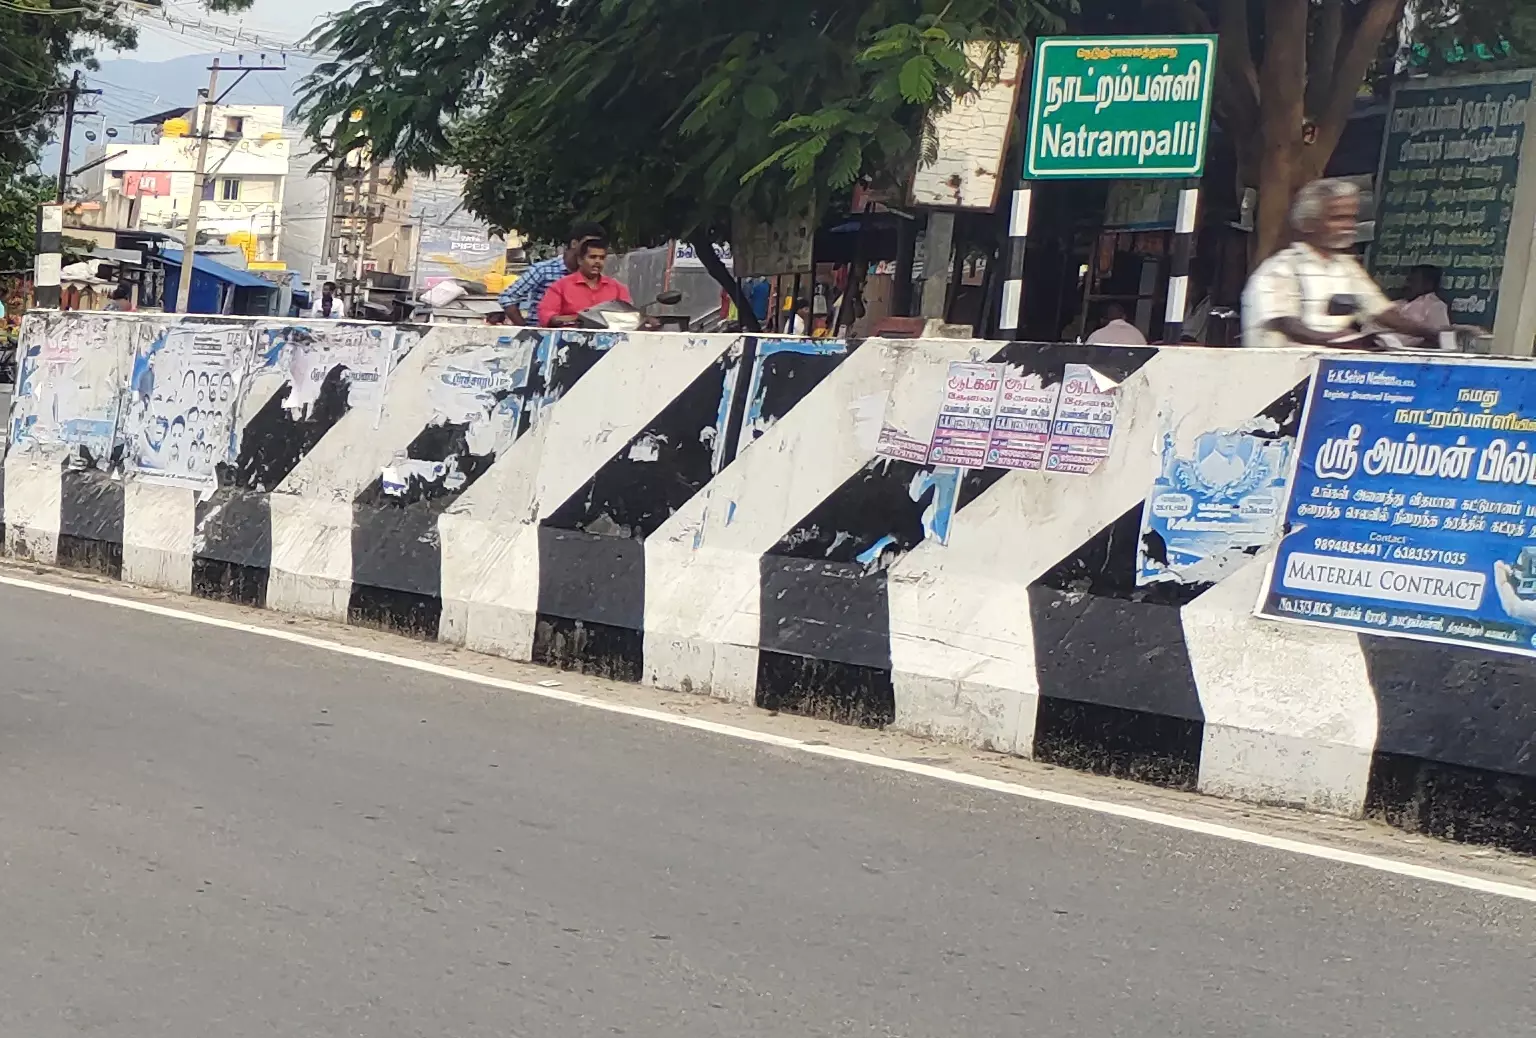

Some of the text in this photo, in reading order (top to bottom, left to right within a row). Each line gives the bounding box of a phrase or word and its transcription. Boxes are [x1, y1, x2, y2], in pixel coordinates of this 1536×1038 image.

[1043, 59, 1201, 117] நாட்றம்பள்ளி
[1040, 121, 1197, 164] Natrampalli
[451, 242, 490, 251] PIPES
[1457, 388, 1500, 408] நமது
[1363, 432, 1476, 480] அம்மன்
[1311, 483, 1349, 500] உங்கள்
[1409, 492, 1456, 509] விதமான
[1288, 559, 1482, 601] MATERIAL CONTRACT
